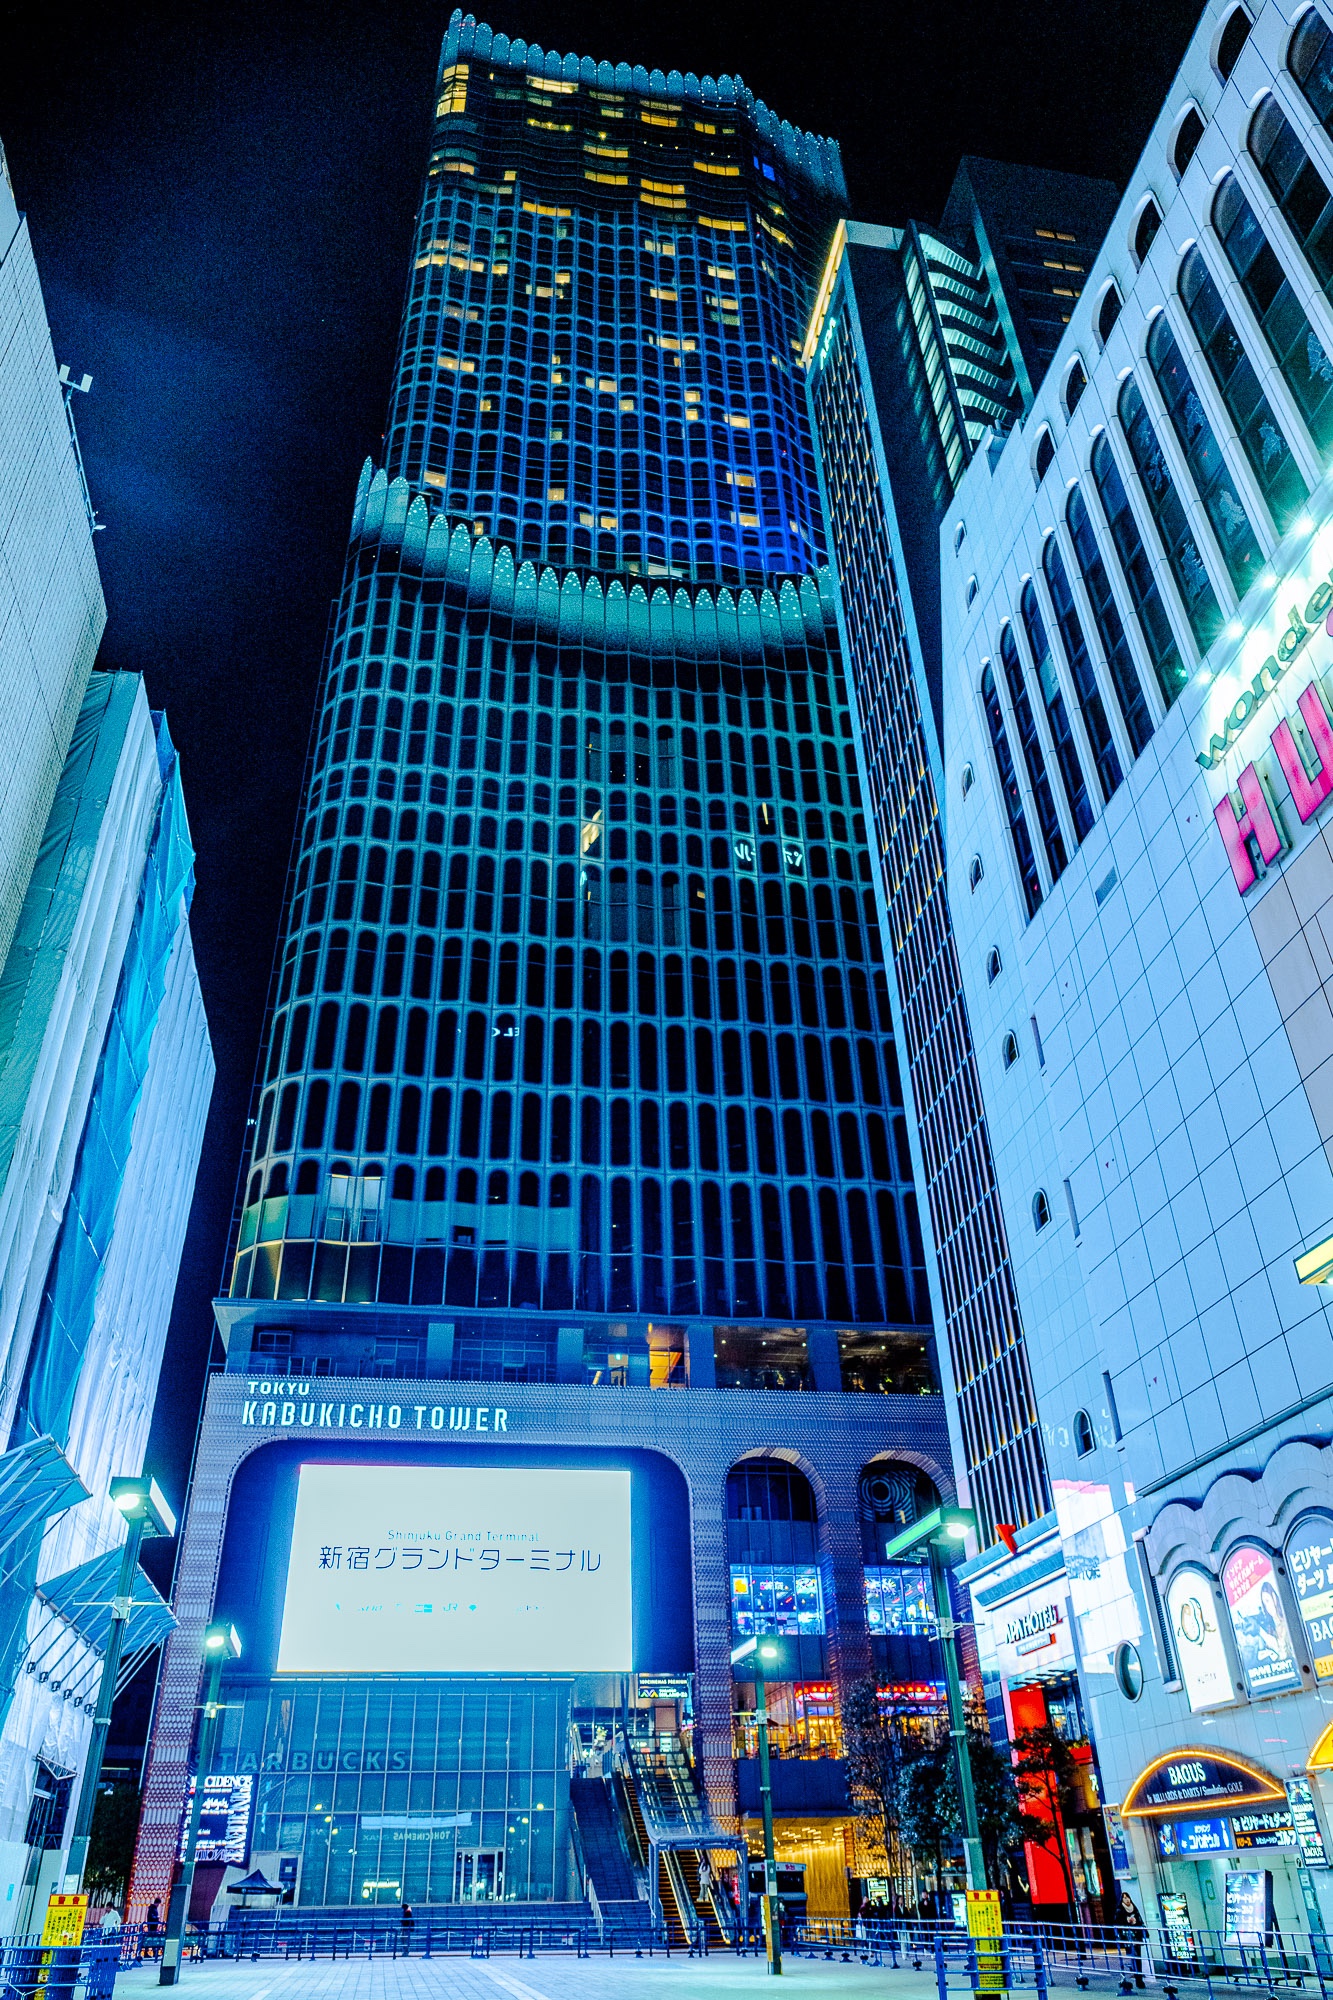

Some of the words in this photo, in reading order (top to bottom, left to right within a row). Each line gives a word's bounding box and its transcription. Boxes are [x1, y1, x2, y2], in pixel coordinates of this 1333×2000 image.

[1195, 568, 1333, 770] wonde
[248, 1381, 309, 1395] TOKYU
[242, 1401, 401, 1429] KABUKICHO
[414, 1405, 507, 1431] TOWER
[388, 1529, 441, 1542] Shinjuku
[445, 1530, 481, 1541] Grand
[487, 1531, 539, 1542] Terminal
[318, 1546, 601, 1571] 新宿グランドターミナル
[1022, 1605, 1060, 1637] HOTEL
[1182, 1786, 1200, 1798] DARTS
[1227, 1781, 1243, 1793] GOLF
